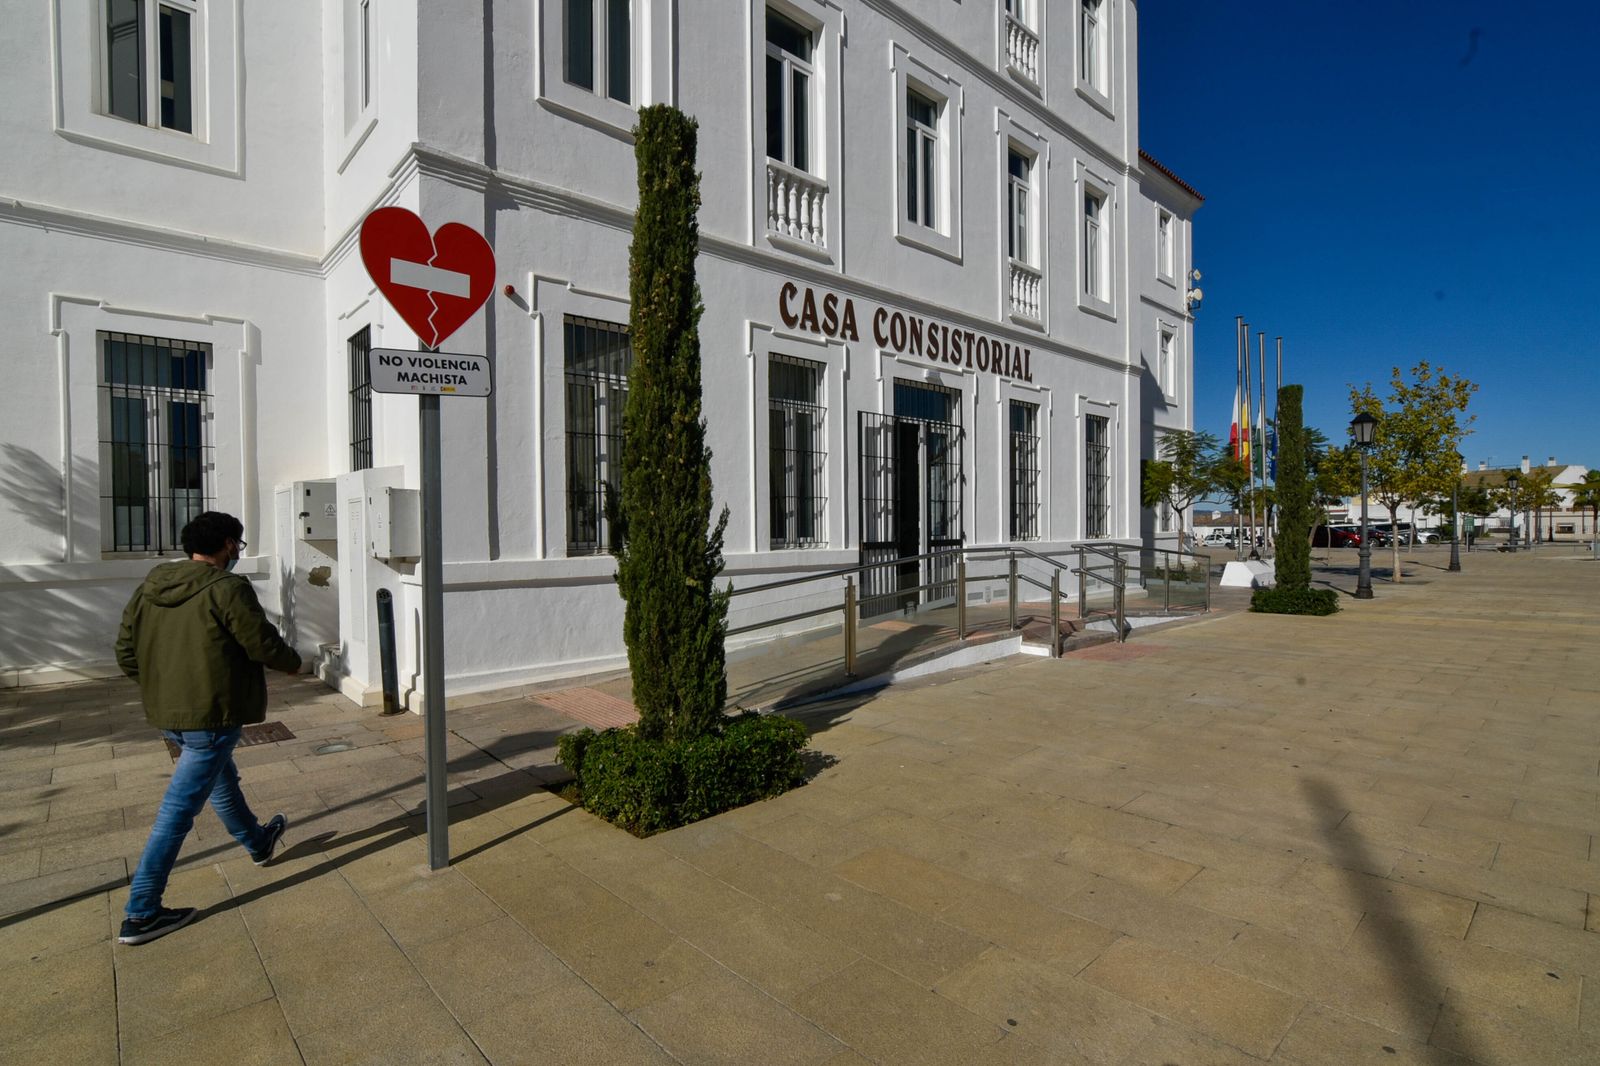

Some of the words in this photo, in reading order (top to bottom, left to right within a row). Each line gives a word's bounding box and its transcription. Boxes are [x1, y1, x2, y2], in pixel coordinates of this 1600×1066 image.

[779, 281, 859, 342] CASA
[873, 307, 1033, 383] CONSISTORIAL
[378, 355, 403, 366] NO
[408, 357, 480, 371] VIOLENCIA
[397, 372, 468, 385] MACHISTA
